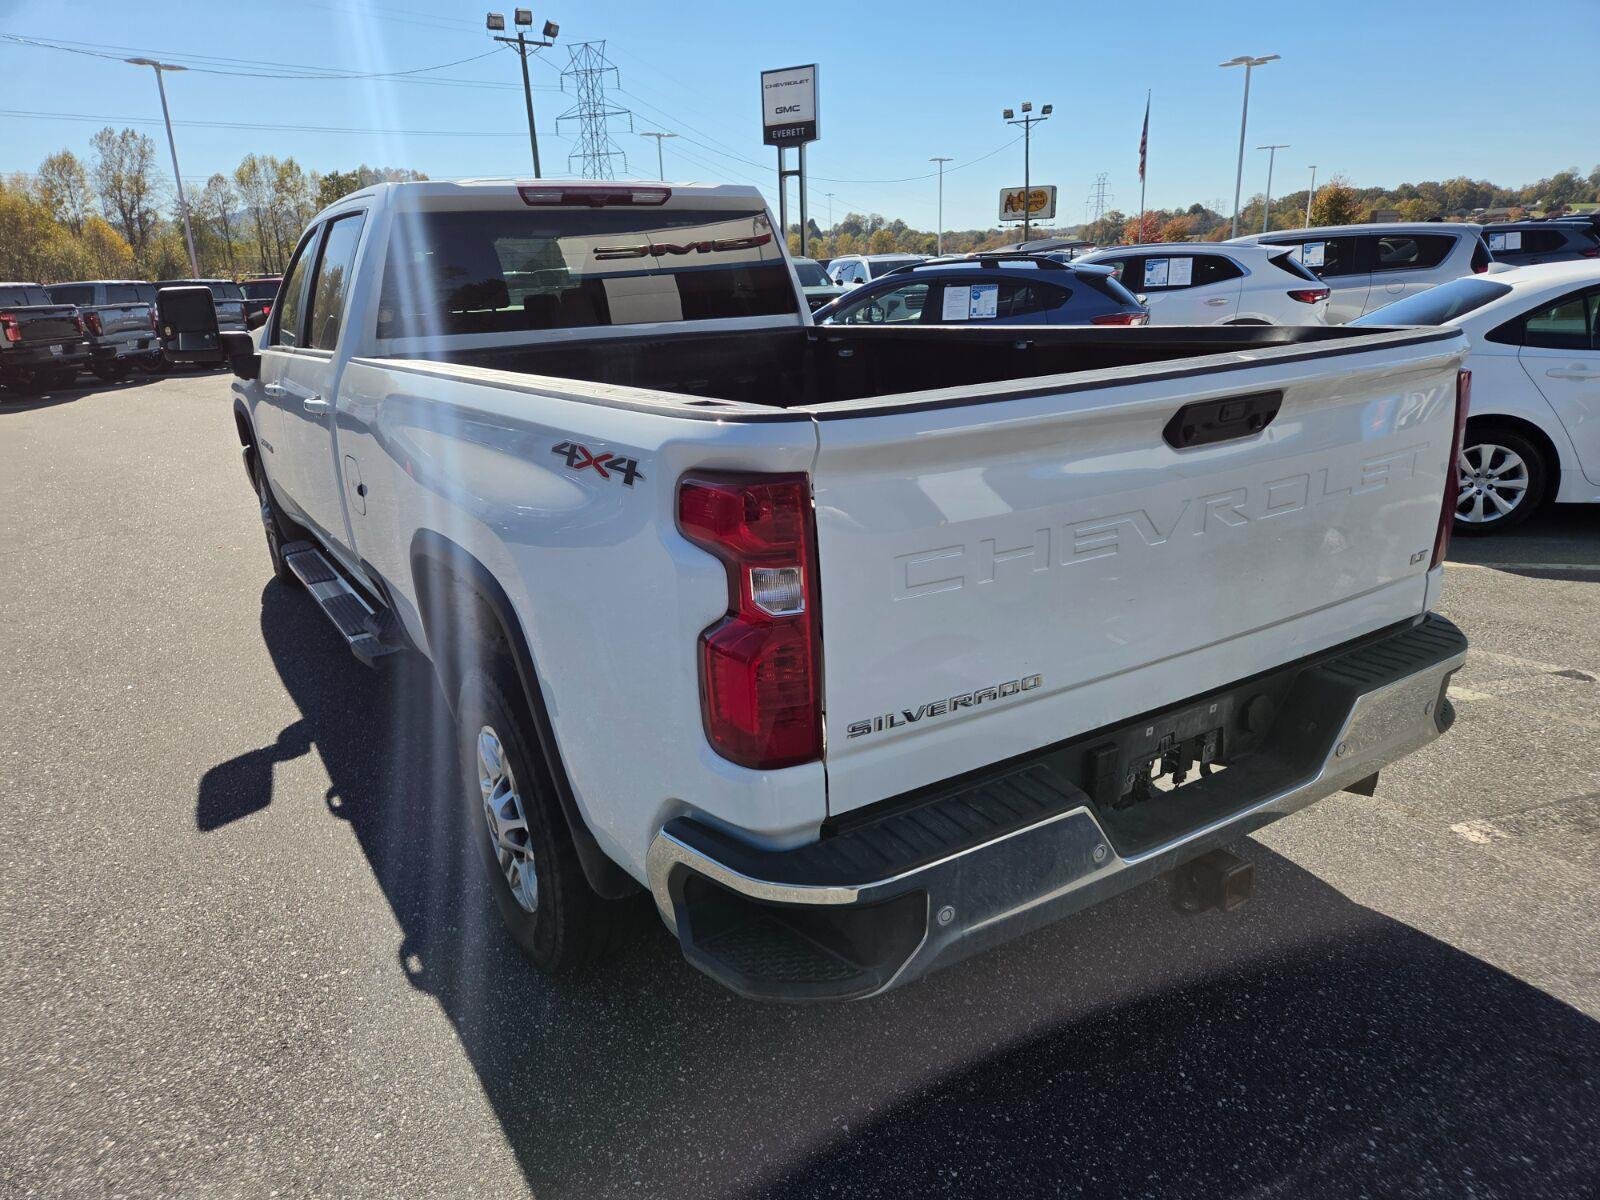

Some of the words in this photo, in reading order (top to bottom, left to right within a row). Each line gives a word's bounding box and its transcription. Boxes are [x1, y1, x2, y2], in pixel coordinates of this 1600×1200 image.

[765, 78, 810, 90] CHEVROLET
[775, 105, 801, 114] GMC
[772, 127, 805, 138] EVERETT
[892, 441, 1433, 602] CHEVROLET
[1410, 549, 1429, 566] LT
[847, 673, 1043, 739] SILVERADO
